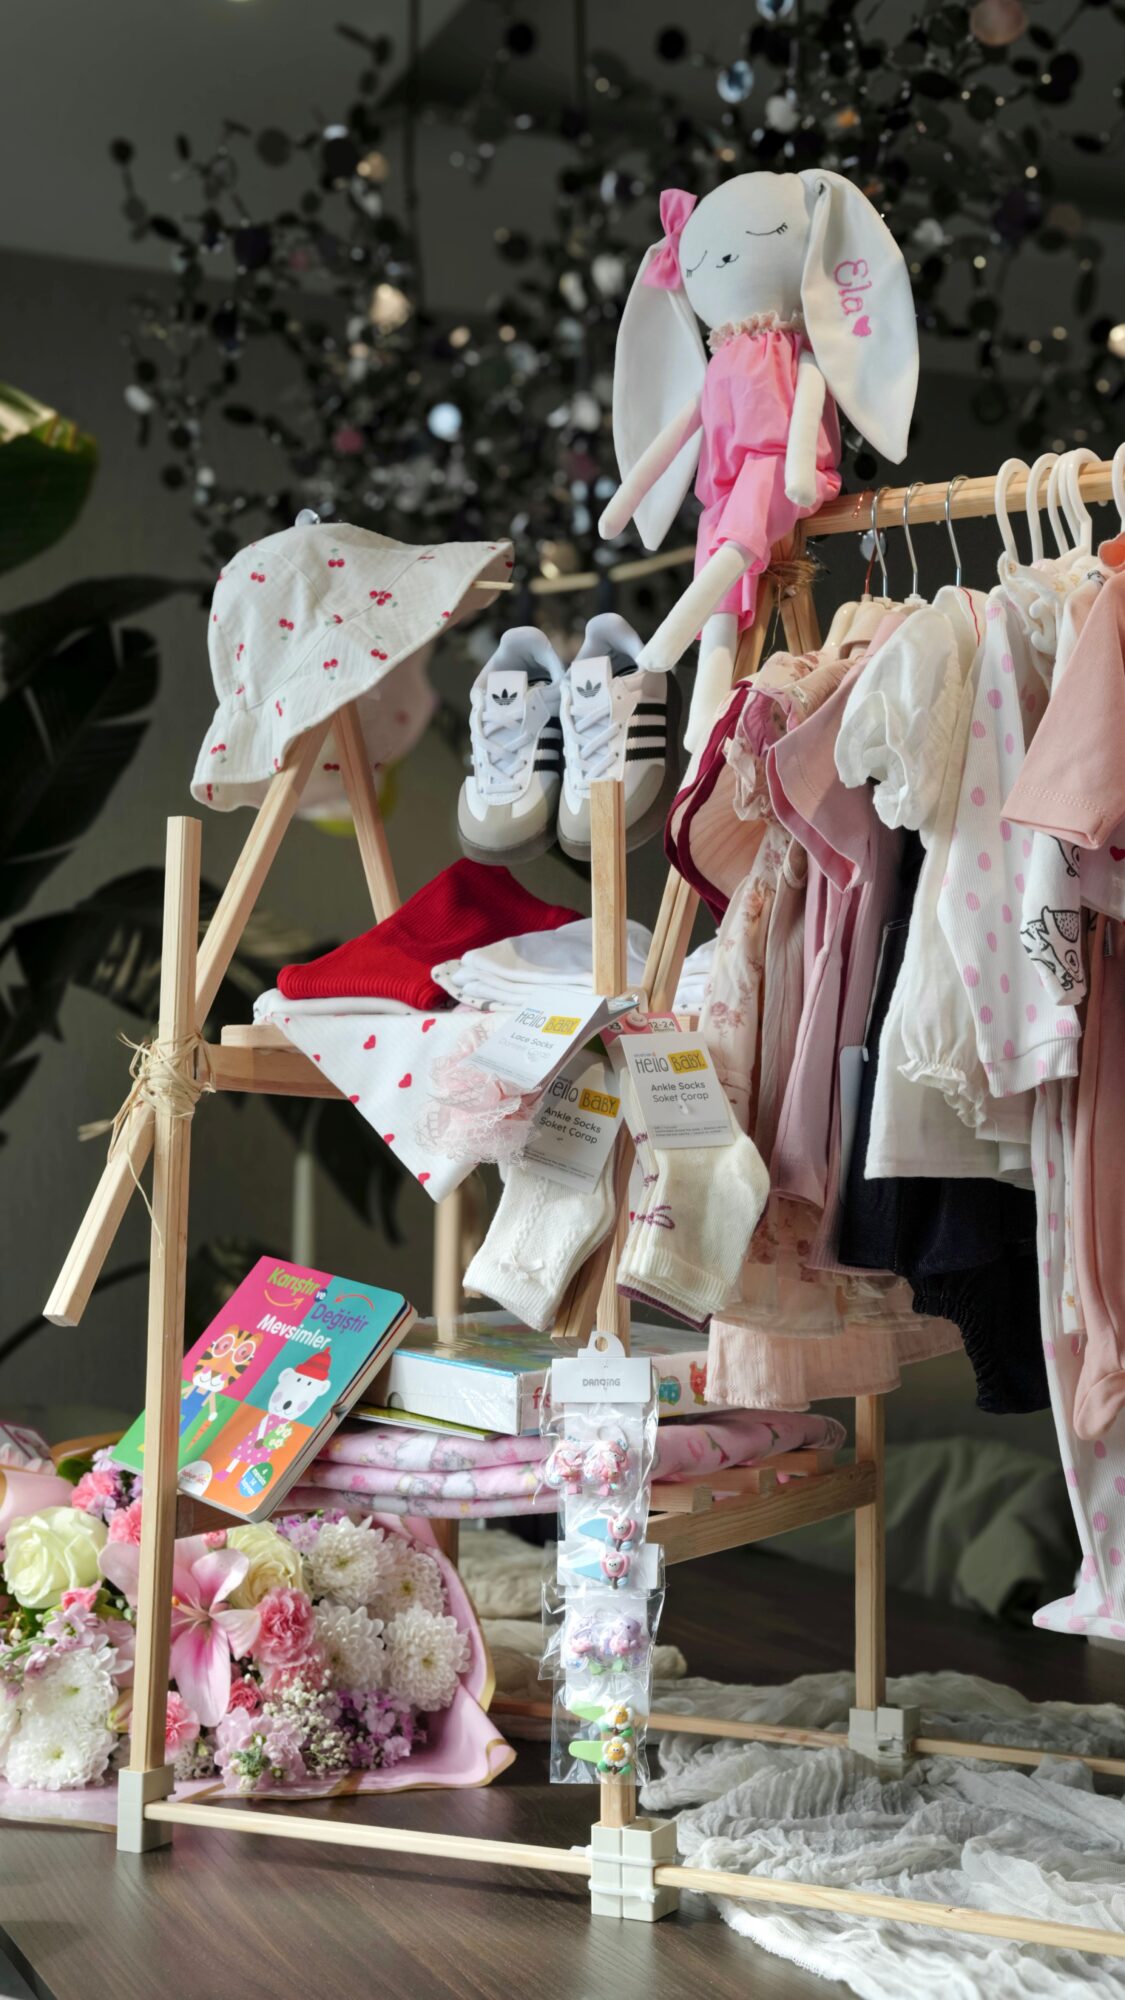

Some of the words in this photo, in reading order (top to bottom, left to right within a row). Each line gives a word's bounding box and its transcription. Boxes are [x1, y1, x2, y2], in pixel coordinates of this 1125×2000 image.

[833, 258, 873, 316] Ela
[510, 1032, 530, 1043] Lace
[530, 1038, 554, 1049] Socks
[634, 1057, 669, 1075] Hello
[651, 1083, 677, 1092] Ankle
[678, 1081, 706, 1091] Socks
[652, 1093, 678, 1103] Soket
[680, 1092, 709, 1102] Çorap
[538, 1116, 567, 1133] Soket
[568, 1127, 598, 1145] Çorap
[544, 1106, 572, 1123] Ankle
[574, 1117, 602, 1134] Socks
[315, 1290, 327, 1300] ve
[311, 1303, 370, 1335] Değiştir
[256, 1313, 333, 1350] Mevsimler
